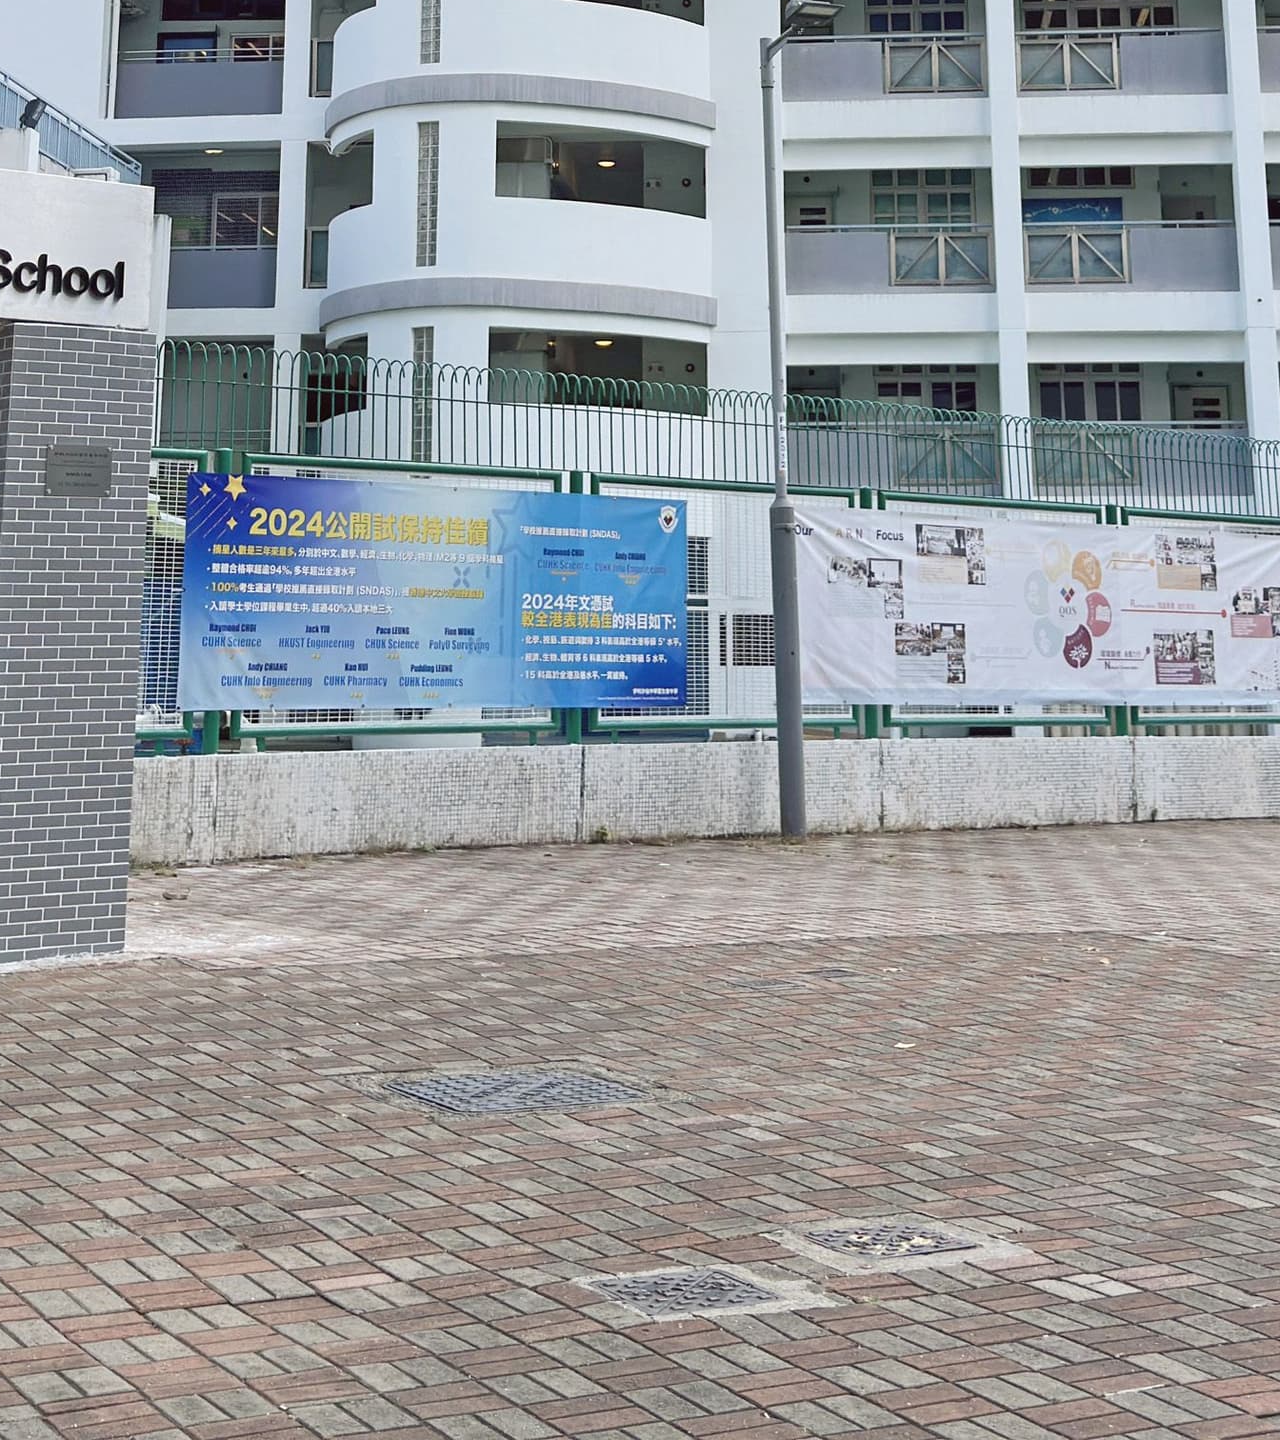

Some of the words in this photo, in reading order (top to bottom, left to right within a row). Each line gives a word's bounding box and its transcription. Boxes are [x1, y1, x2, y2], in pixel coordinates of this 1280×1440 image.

[248, 507, 490, 546] 2024公開試保持佳績
[794, 525, 813, 536] Our
[876, 529, 904, 541] Focus
[522, 593, 614, 611] 2024年文憑試
[201, 636, 226, 647] CUHK
[227, 636, 262, 648] Science
[279, 637, 305, 648] HKUST
[306, 637, 355, 650] Engineering
[387, 639, 420, 649] Science
[221, 675, 243, 686] CUHK
[262, 676, 313, 687] Engineering
[323, 675, 346, 686] CUHK
[347, 675, 388, 687] Pharmacy
[399, 676, 421, 687] CUHK
[421, 676, 464, 687] Economics
